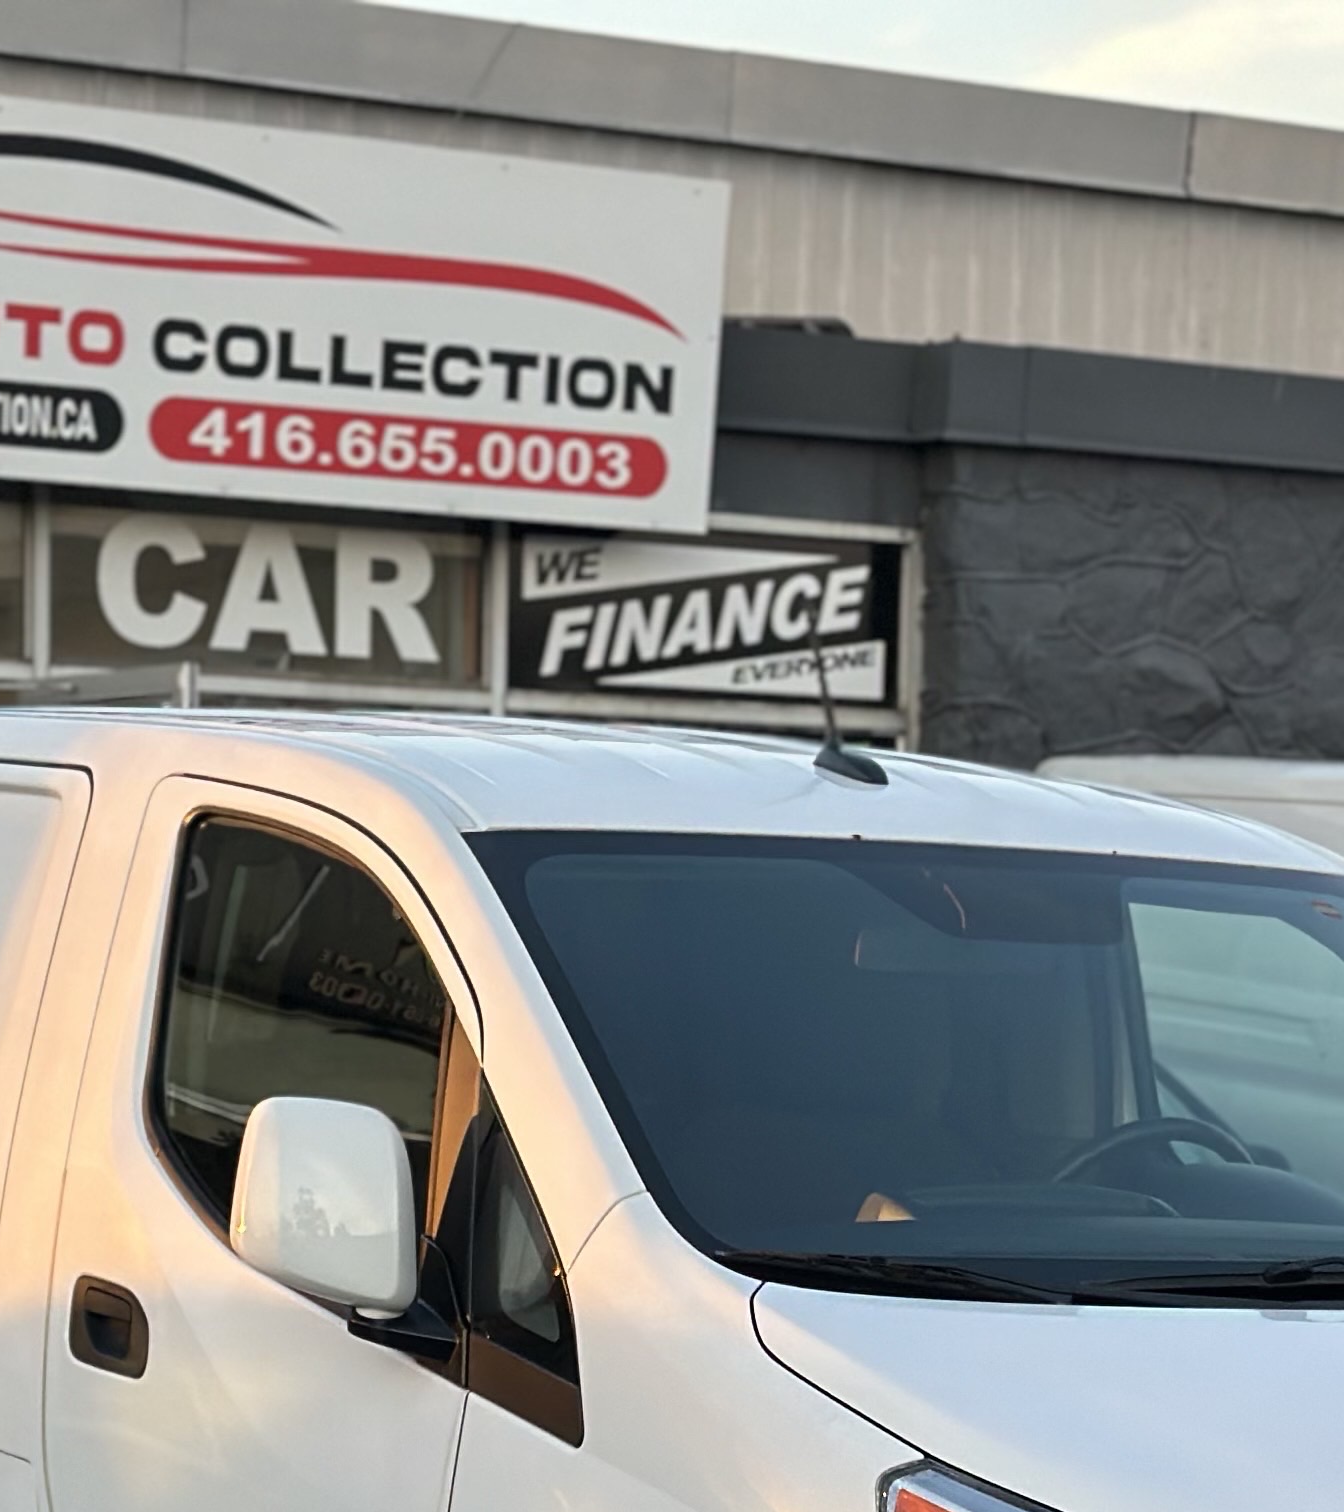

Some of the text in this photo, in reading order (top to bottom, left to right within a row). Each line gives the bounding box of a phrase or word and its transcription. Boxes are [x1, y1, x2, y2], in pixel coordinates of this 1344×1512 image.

[152, 317, 675, 416] COLLECTION
[96, 511, 441, 664] CAR
[534, 545, 603, 586] WE
[539, 564, 871, 678] FINANCE
